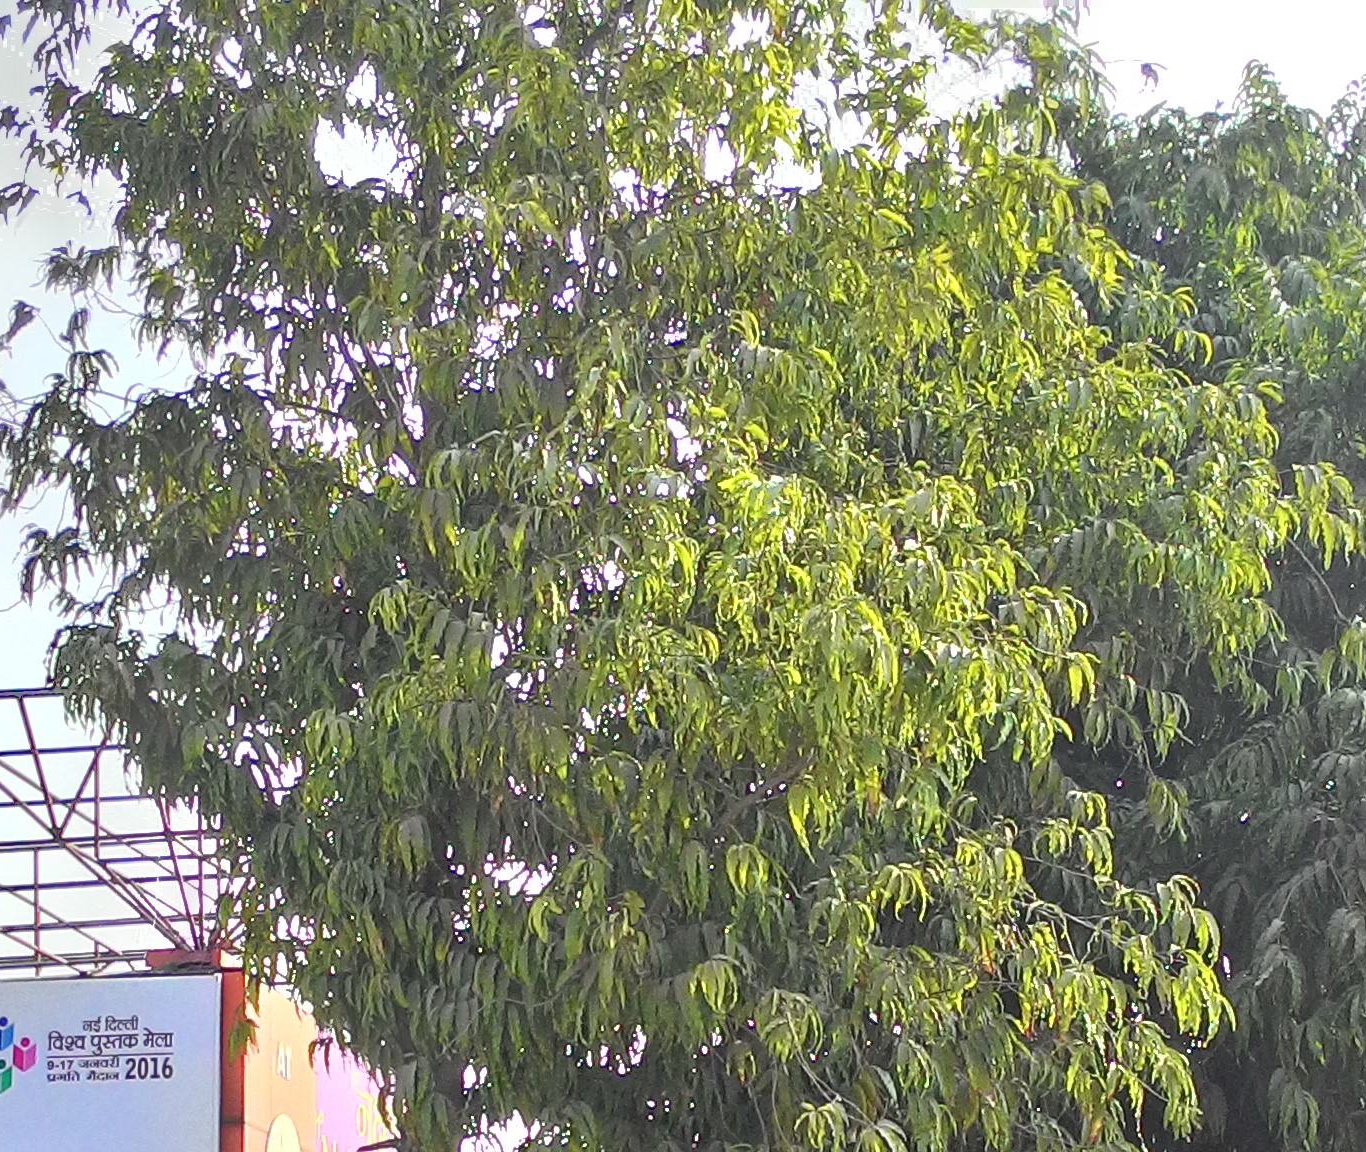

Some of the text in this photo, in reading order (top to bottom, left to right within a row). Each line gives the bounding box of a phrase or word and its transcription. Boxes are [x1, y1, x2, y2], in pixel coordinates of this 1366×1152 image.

[82, 1014, 139, 1032] नई दिल्ली
[47, 1028, 174, 1055] विश्व पुस्तक मेला
[47, 1060, 75, 1071] 9-17
[125, 1057, 174, 1080] 2016
